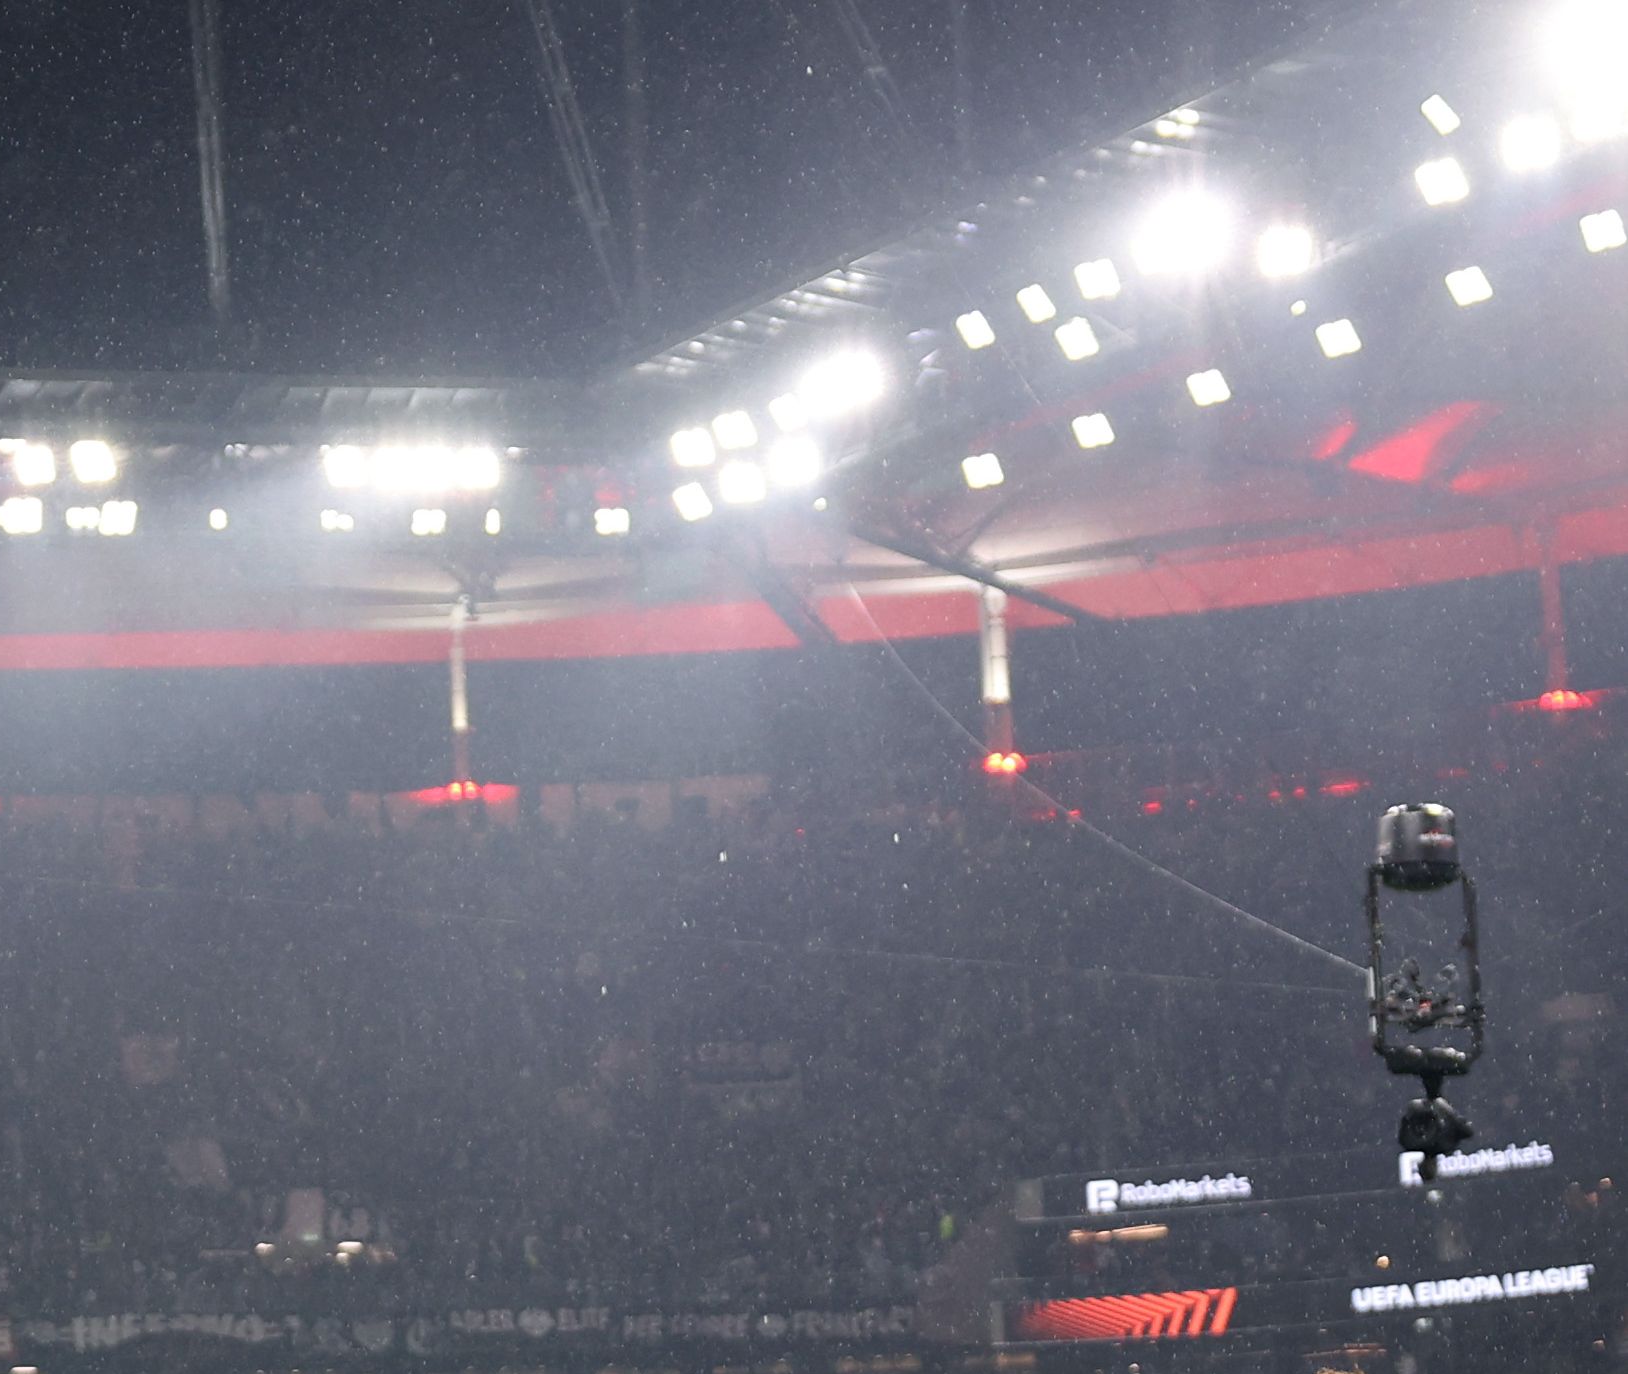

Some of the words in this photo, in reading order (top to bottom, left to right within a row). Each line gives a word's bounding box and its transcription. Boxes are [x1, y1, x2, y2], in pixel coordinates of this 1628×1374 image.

[1351, 1284, 1415, 1312] UEFA
[1414, 1274, 1505, 1307] EUROPA
[1503, 1265, 1594, 1298] LEAGUE
